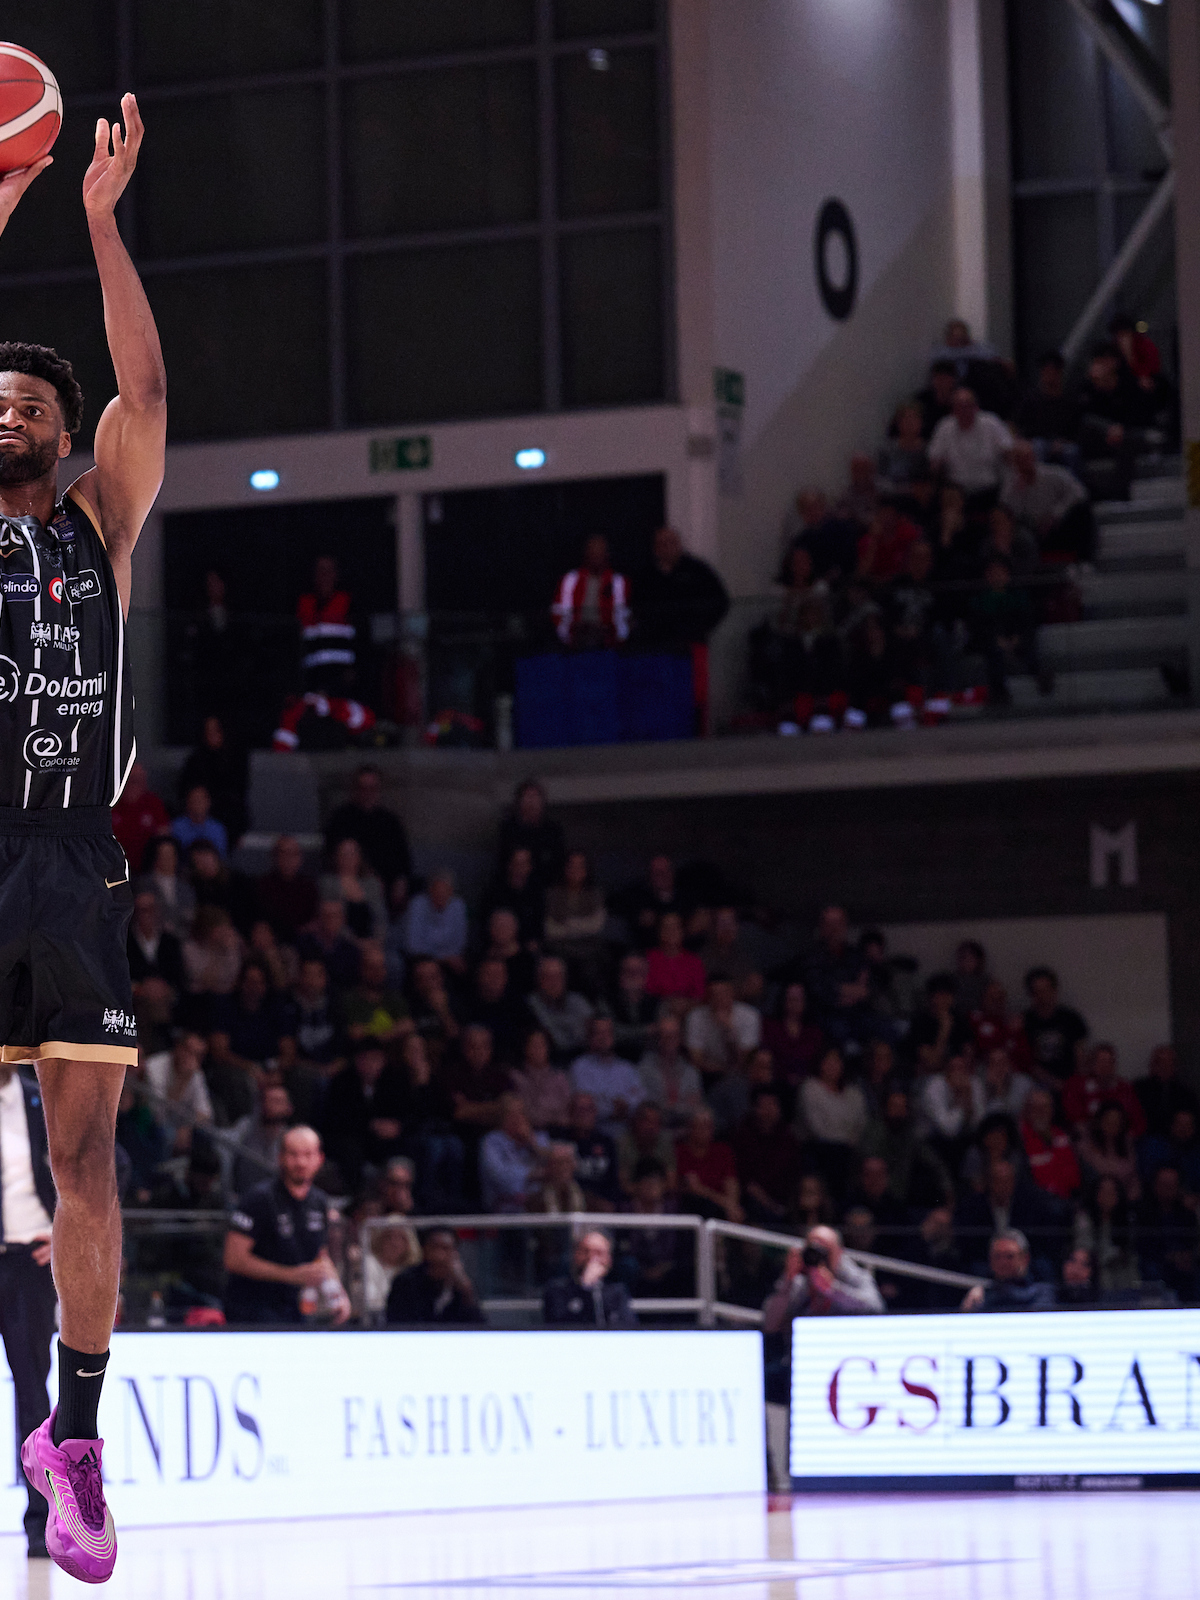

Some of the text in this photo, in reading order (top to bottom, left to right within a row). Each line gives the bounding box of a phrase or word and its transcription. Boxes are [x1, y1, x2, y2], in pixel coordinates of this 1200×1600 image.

[1, 579, 38, 593] elinda
[1089, 819, 1139, 889] M
[342, 1393, 535, 1458] FASHION
[584, 1387, 741, 1450] LUXURY
[827, 1351, 1200, 1433] GSBRA
